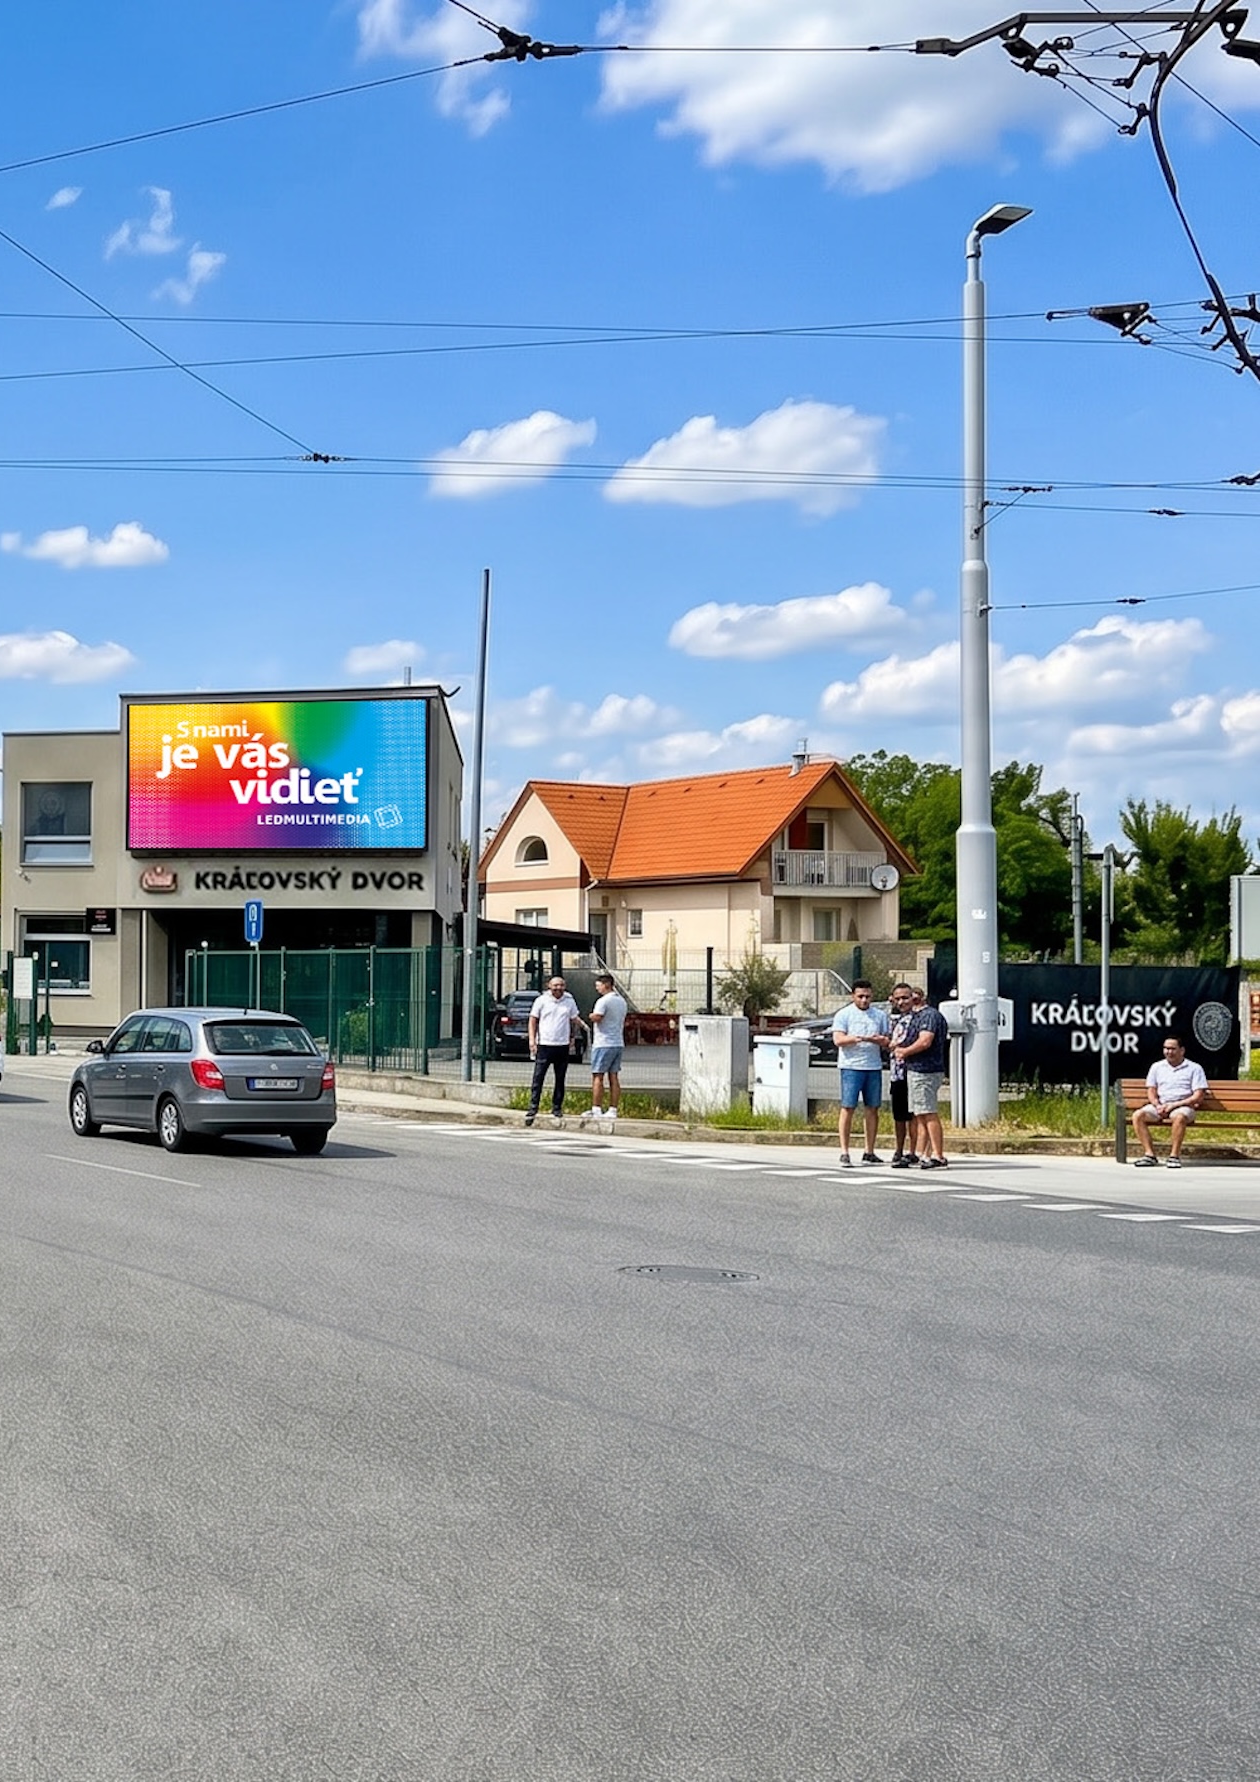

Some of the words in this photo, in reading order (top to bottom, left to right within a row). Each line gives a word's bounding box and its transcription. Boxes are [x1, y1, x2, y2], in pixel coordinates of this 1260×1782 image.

[177, 721, 190, 738] S
[193, 719, 249, 738] nami
[156, 735, 199, 779] je
[213, 733, 290, 770] vás
[229, 767, 364, 805] vidieť
[257, 813, 372, 826] LEDMULTIMEDIA
[352, 871, 425, 891] DVOR
[1071, 1031, 1140, 1054] DVOR
